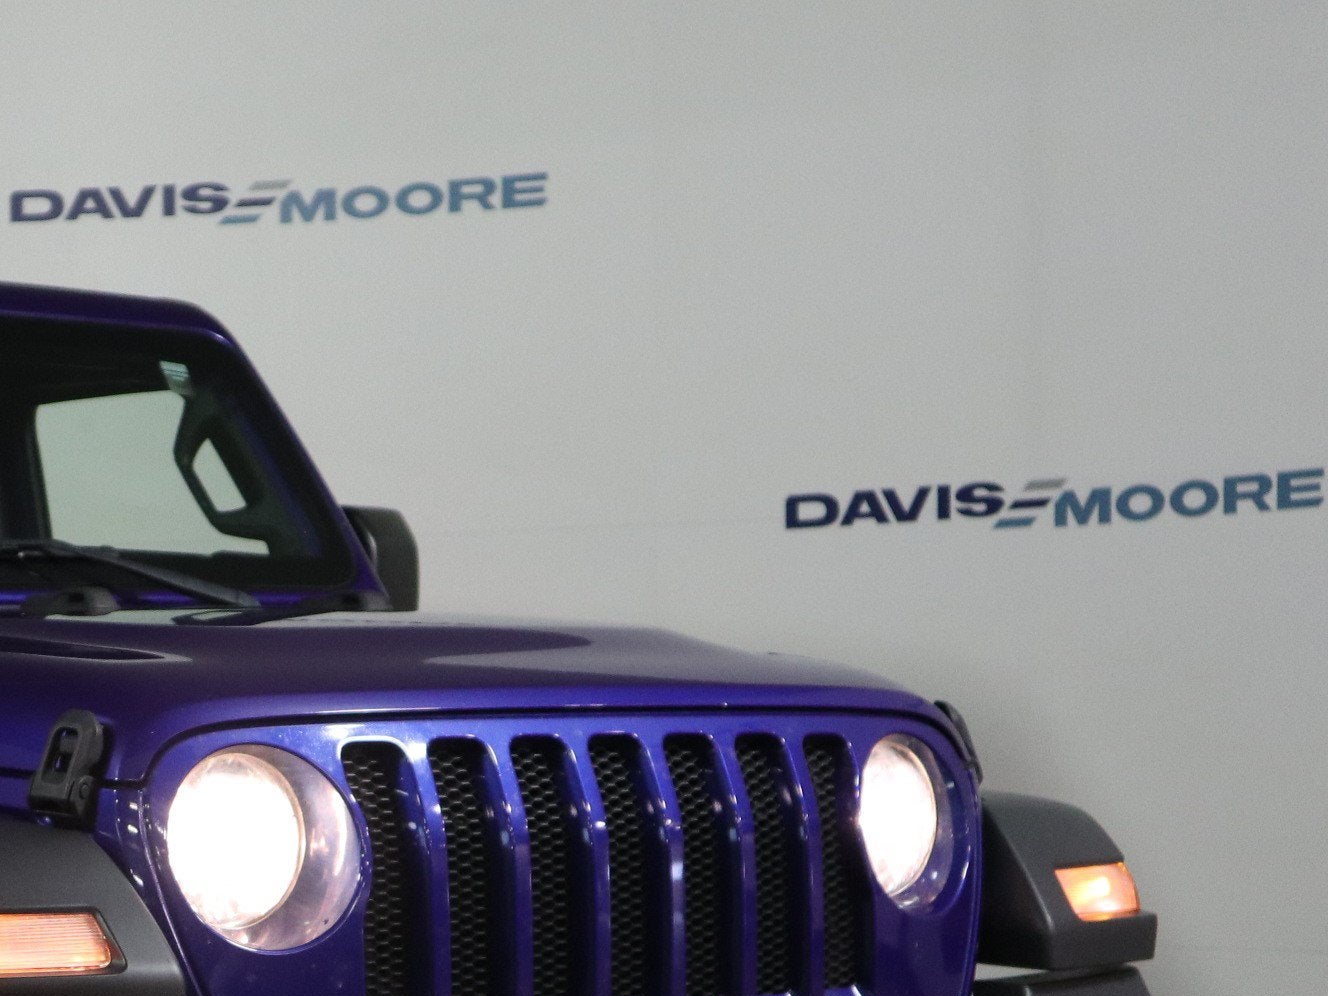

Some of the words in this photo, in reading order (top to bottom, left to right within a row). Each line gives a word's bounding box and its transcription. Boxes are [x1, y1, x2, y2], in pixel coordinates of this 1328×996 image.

[9, 182, 232, 223] DAVIS
[279, 171, 549, 225] MOORE
[784, 482, 1006, 530] DAVIS
[1053, 467, 1324, 528] MOORE
